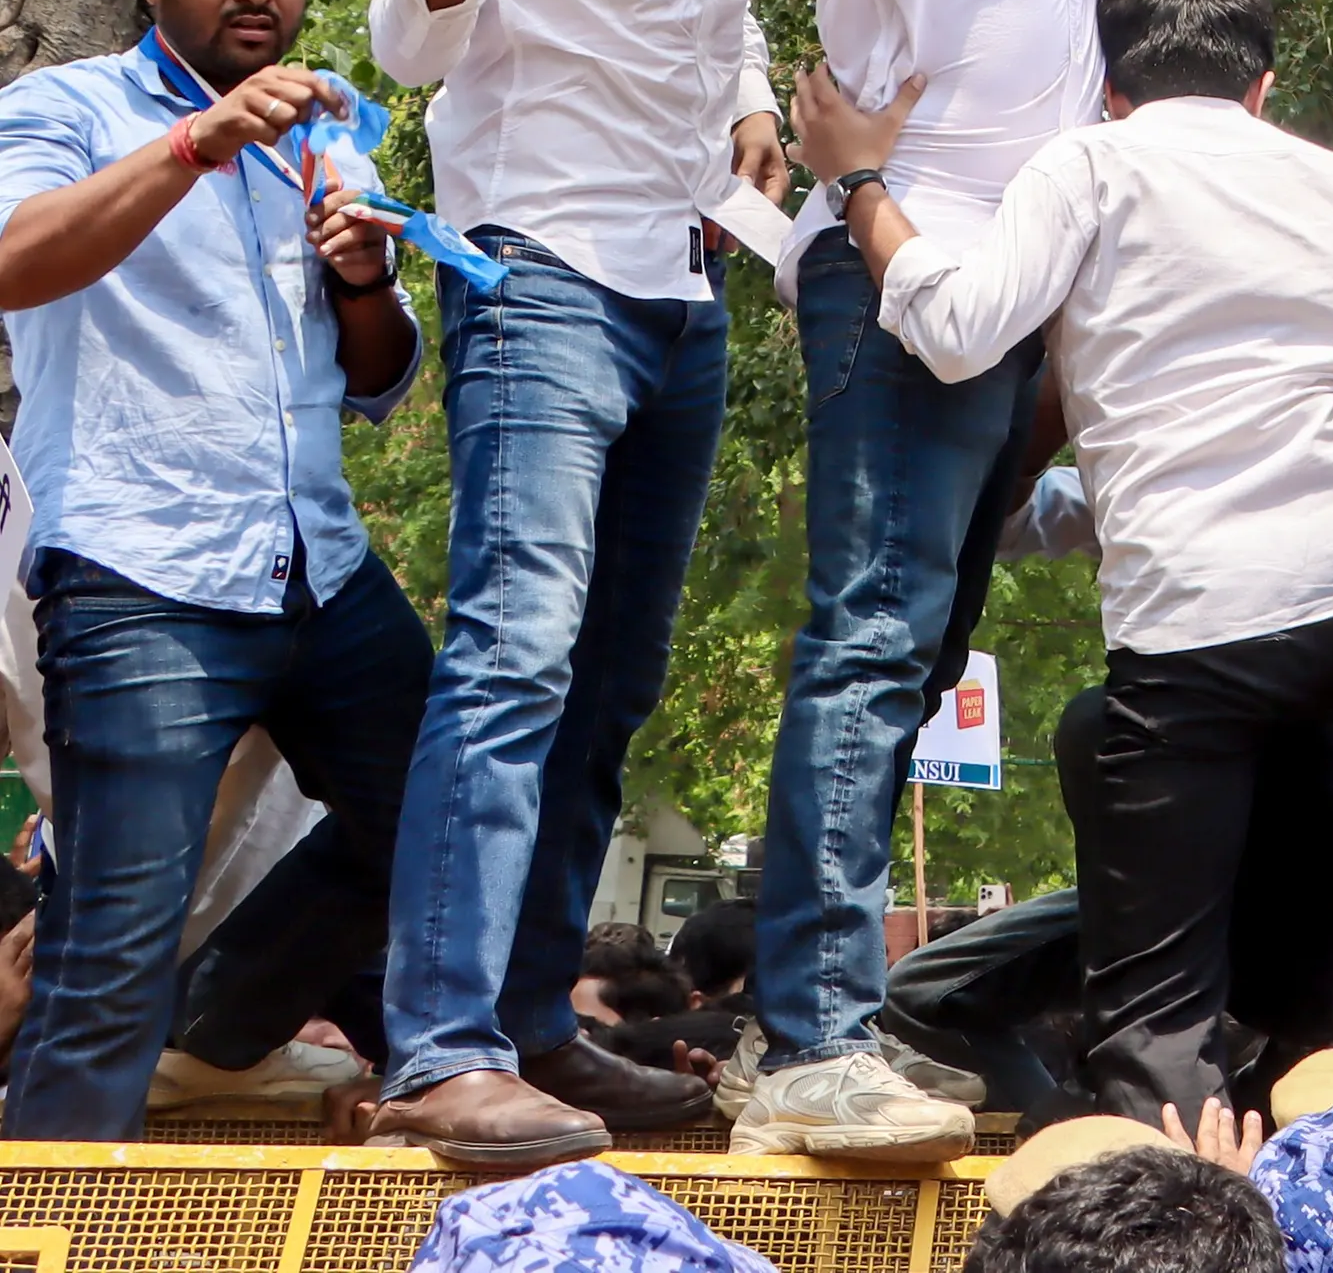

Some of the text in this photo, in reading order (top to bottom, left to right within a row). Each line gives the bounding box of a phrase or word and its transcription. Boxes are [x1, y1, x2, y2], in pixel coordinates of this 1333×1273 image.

[961, 696, 983, 708] PAPER
[963, 708, 982, 719] LEAK
[913, 760, 961, 782] NSUI
